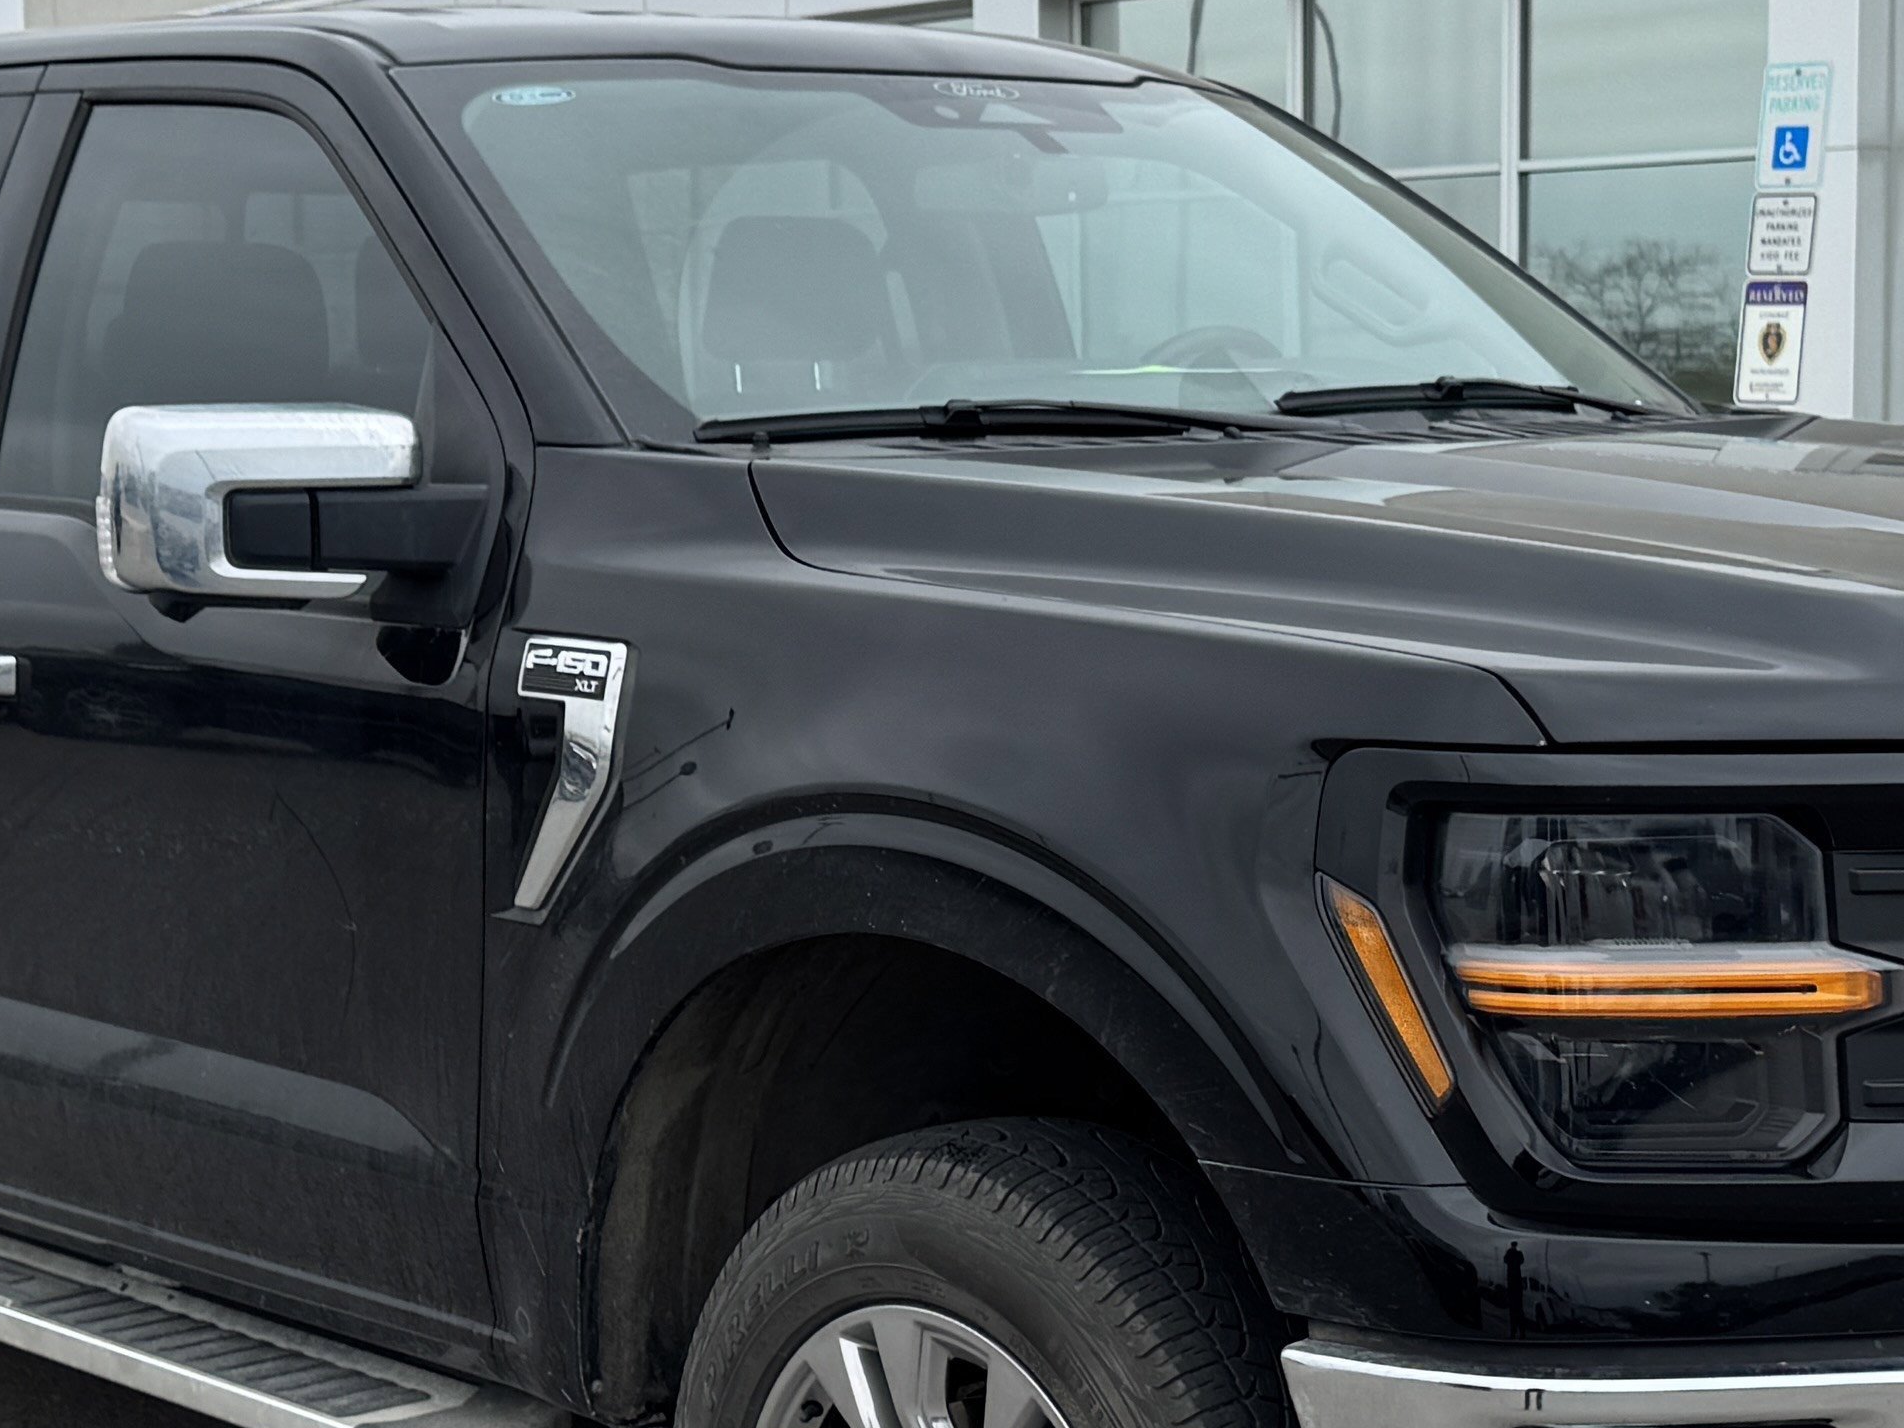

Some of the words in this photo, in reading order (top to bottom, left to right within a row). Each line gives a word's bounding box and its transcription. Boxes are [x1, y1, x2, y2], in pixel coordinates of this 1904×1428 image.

[1769, 95, 1820, 114] PARKING
[1766, 222, 1799, 232] PARKING
[1748, 288, 1805, 303] RESERVED
[525, 648, 609, 678] F-150
[573, 678, 599, 694] XLT
[703, 1240, 820, 1413] PIRELLI
